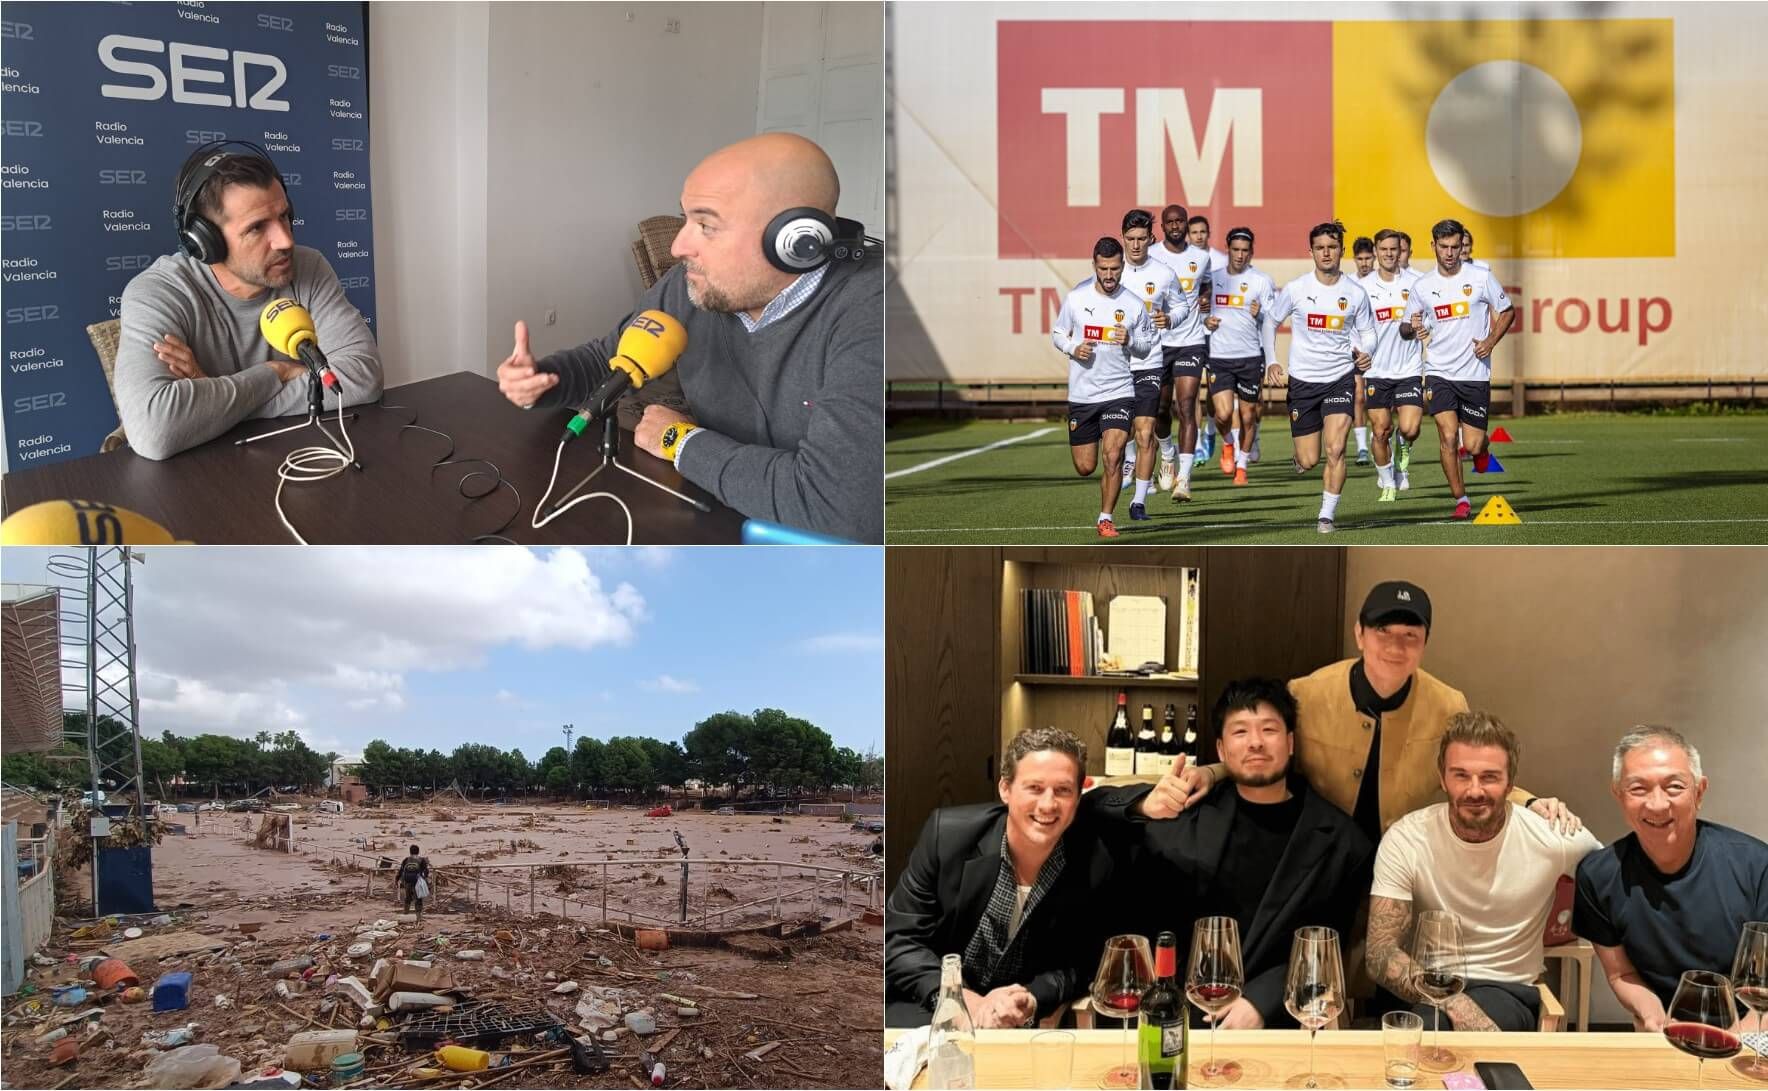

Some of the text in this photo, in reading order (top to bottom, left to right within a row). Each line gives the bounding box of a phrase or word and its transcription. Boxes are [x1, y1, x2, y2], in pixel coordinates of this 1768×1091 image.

[178, 9, 219, 24] Valencia
[257, 14, 294, 32] SER
[326, 22, 347, 33] Radio
[327, 34, 359, 46] Valencia
[1, 67, 20, 78] dio
[98, 34, 290, 112] SER
[328, 64, 360, 80] SER
[1, 81, 40, 94] lencia
[330, 98, 351, 107] Radio
[330, 110, 362, 120] Valencia
[95, 121, 127, 132] Radio
[97, 135, 144, 146] Valencia
[264, 131, 288, 141] Radio
[265, 143, 300, 152] Valencia
[332, 138, 363, 151] SER
[1041, 88, 1263, 207] TM
[1, 164, 30, 174] adio
[334, 171, 354, 179] Radio
[99, 169, 147, 185] SER
[281, 173, 301, 185] ER
[1, 179, 49, 189] alencia
[334, 182, 366, 190] Valencia
[103, 210, 134, 219] Radio
[335, 208, 367, 221] SER
[1, 215, 53, 230] SER
[104, 222, 150, 232] Valencia
[337, 241, 358, 249] Radio
[338, 249, 369, 259] Valencia
[2, 257, 38, 269] Radio
[105, 255, 151, 271] SER
[4, 270, 57, 282] Valencia
[6, 305, 59, 324] SER
[1378, 311, 1390, 320] TM
[1436, 307, 1449, 317] TM
[632, 316, 665, 338] ER
[1310, 317, 1323, 326] TM
[1087, 328, 1100, 338] TM
[10, 347, 45, 360] Radio
[11, 358, 64, 373] Valencia
[14, 392, 67, 413] SER
[18, 434, 53, 448] Radio
[20, 443, 71, 461] Valencia
